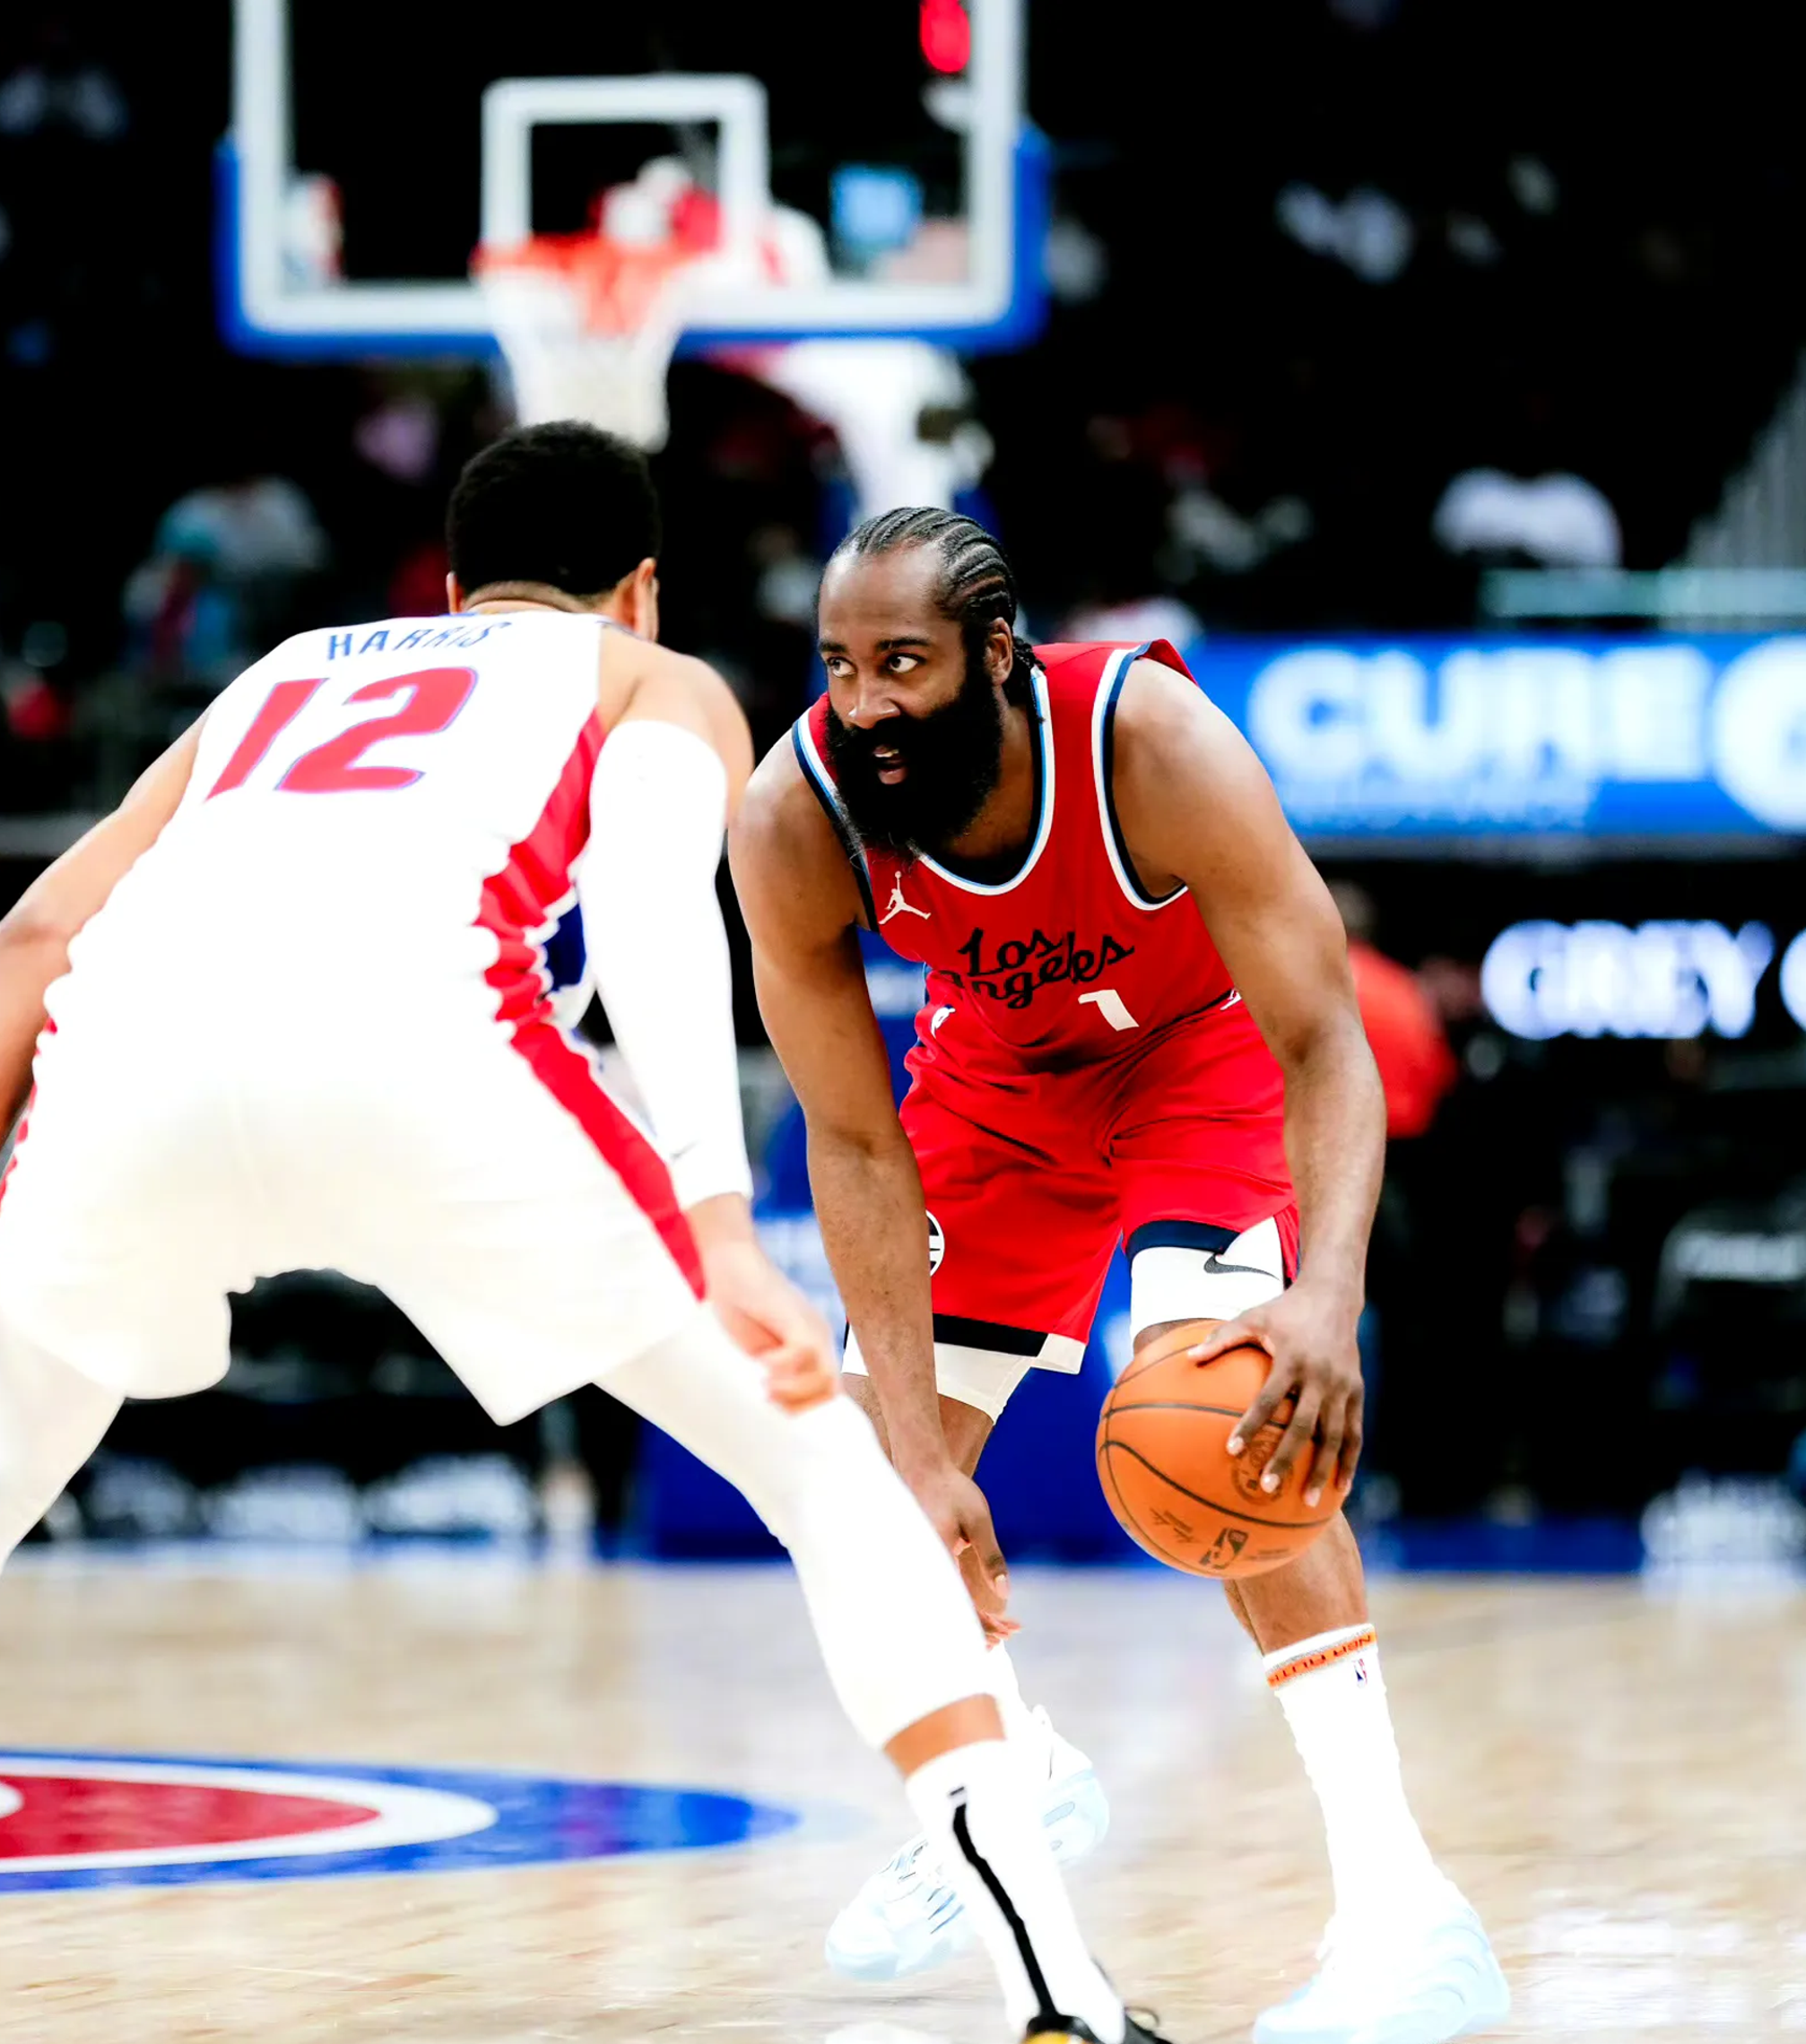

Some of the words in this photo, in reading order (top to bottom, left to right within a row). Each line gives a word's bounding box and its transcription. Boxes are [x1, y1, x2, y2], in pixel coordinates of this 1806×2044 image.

[326, 621, 512, 661] HARRIS
[204, 665, 480, 803] 12
[958, 927, 1064, 977] Los
[1078, 989, 1140, 1031] 1
